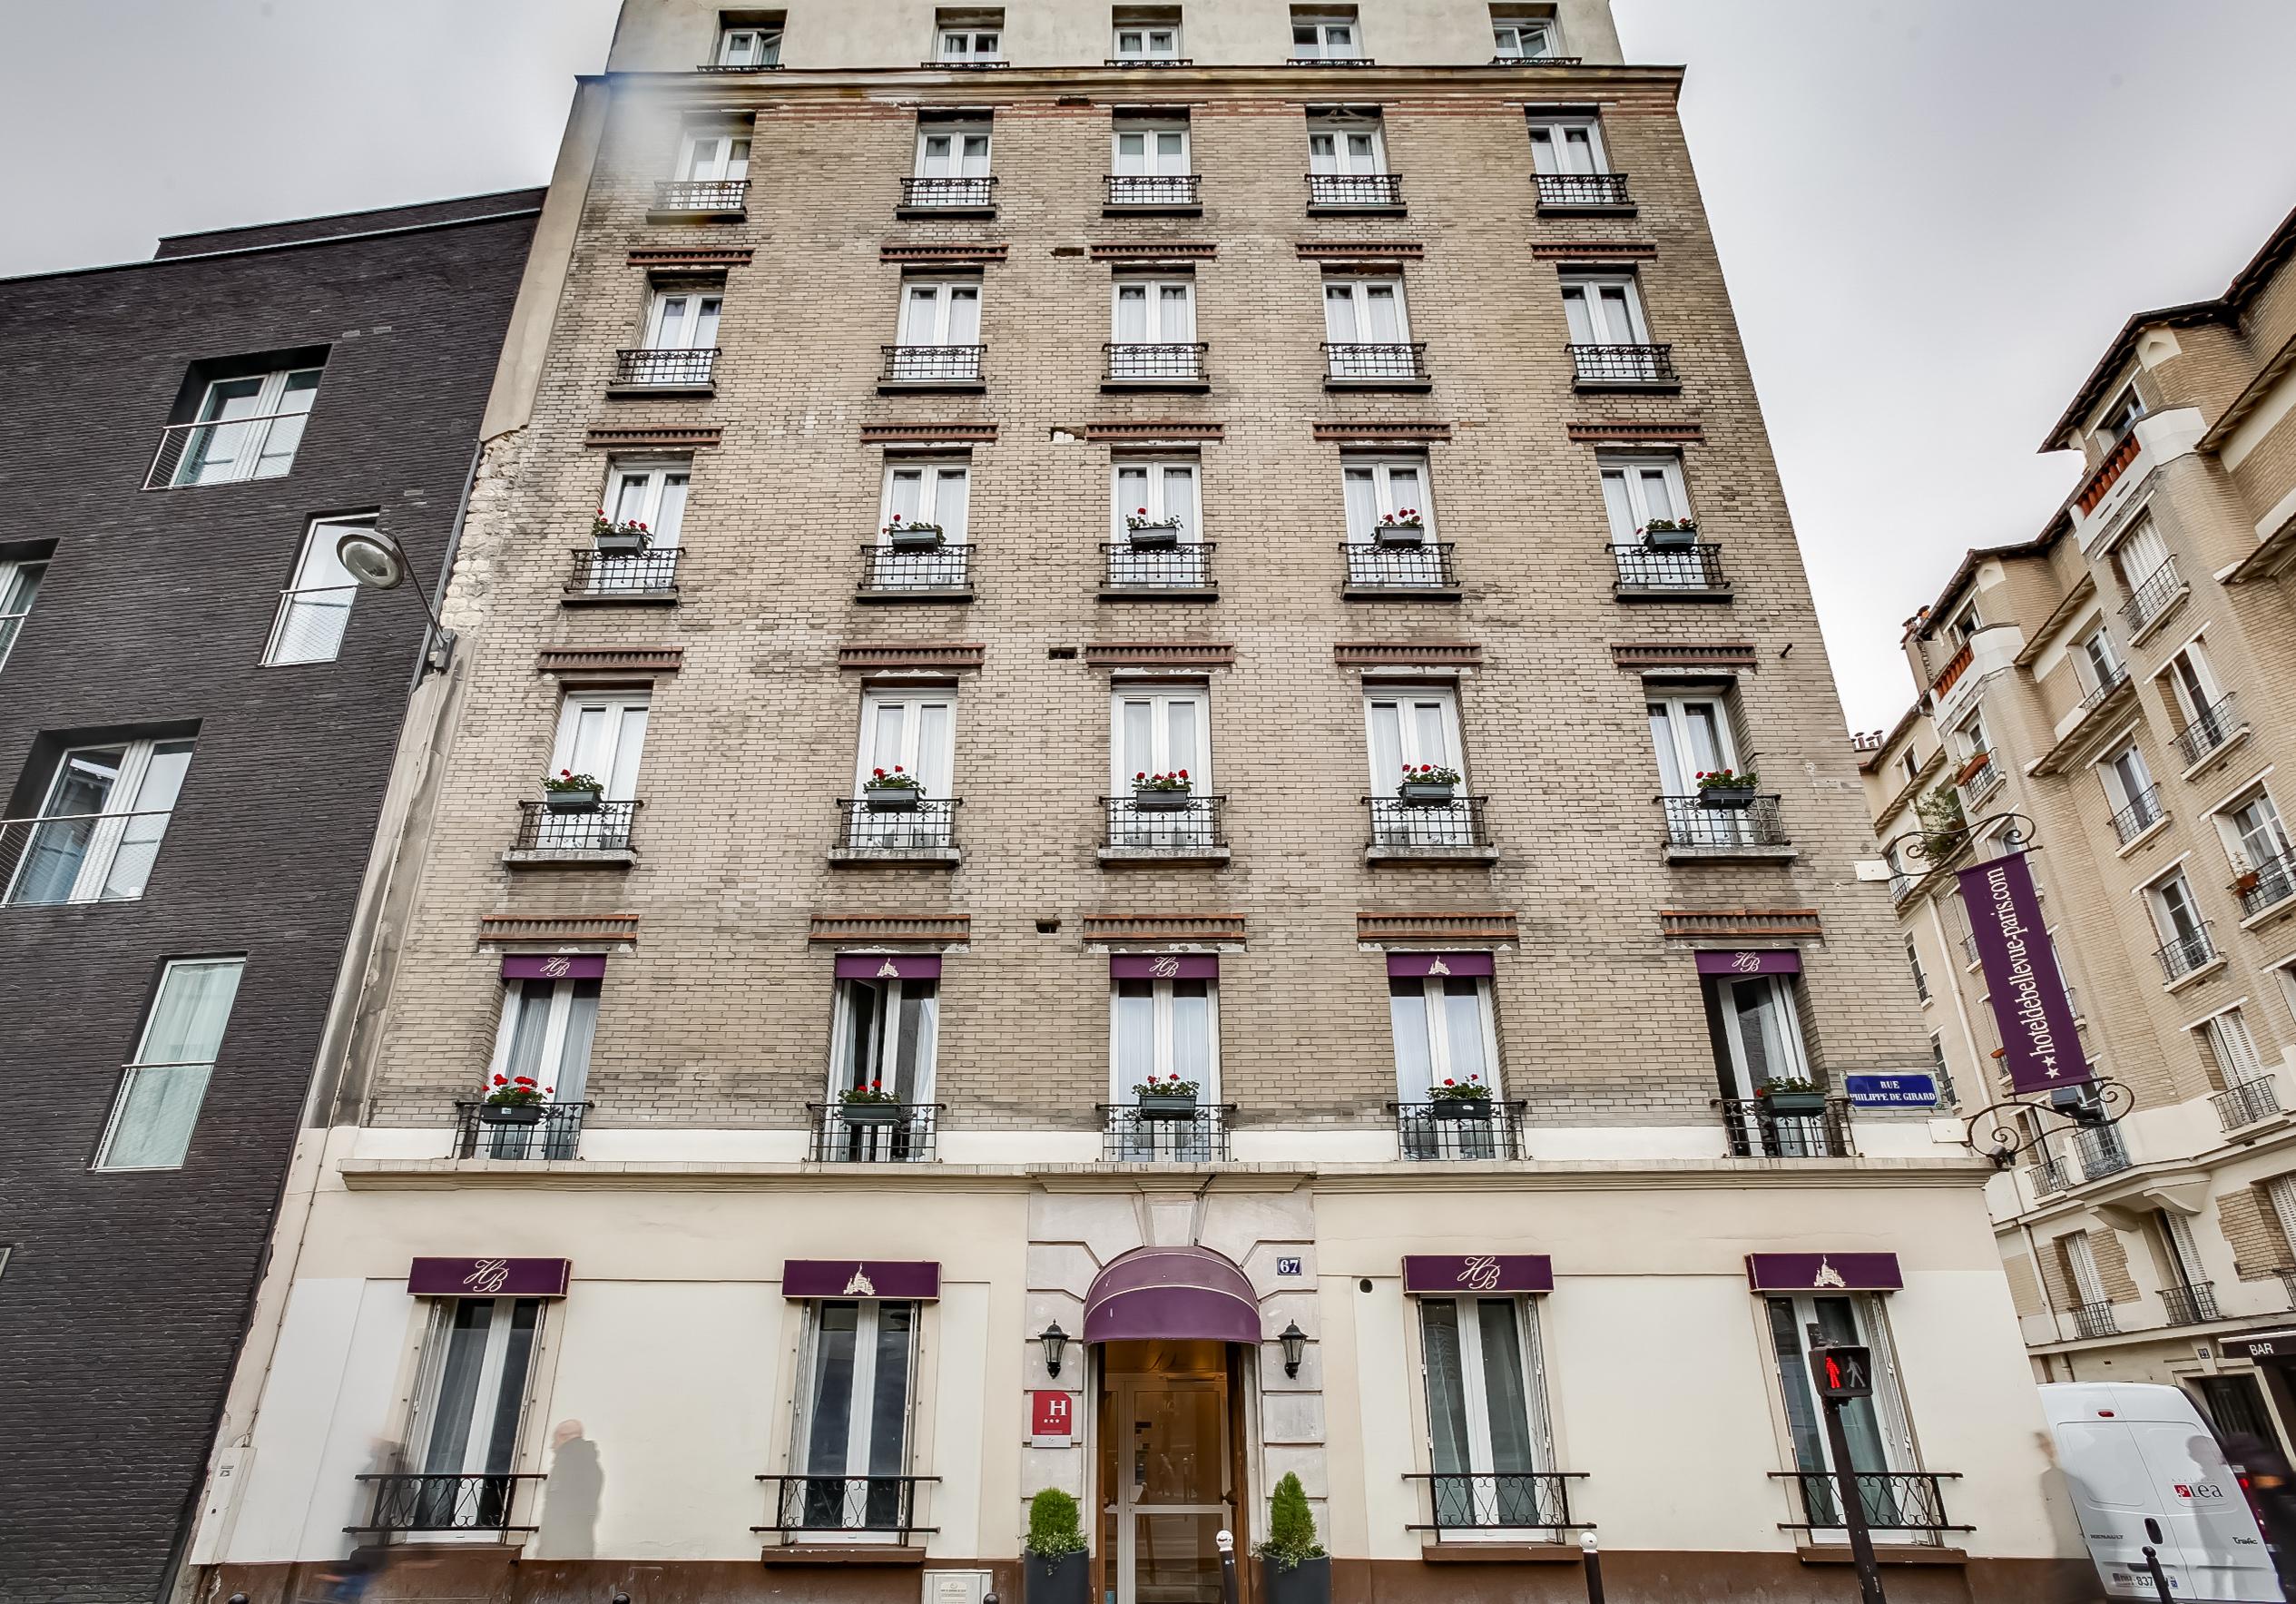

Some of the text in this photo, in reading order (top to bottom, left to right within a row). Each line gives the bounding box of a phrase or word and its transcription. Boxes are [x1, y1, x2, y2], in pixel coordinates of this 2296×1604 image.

[1987, 866, 2056, 1057] hoteldebellevue-paris.com
[1879, 1080, 1900, 1089] RUE
[1850, 1092, 1936, 1101] PHILIPPE DE GIRARD
[1280, 1259, 1300, 1274] 67
[2249, 1343, 2274, 1356] BAR
[1049, 1400, 1067, 1416] H
[2232, 1536, 2259, 1546] Trafic
